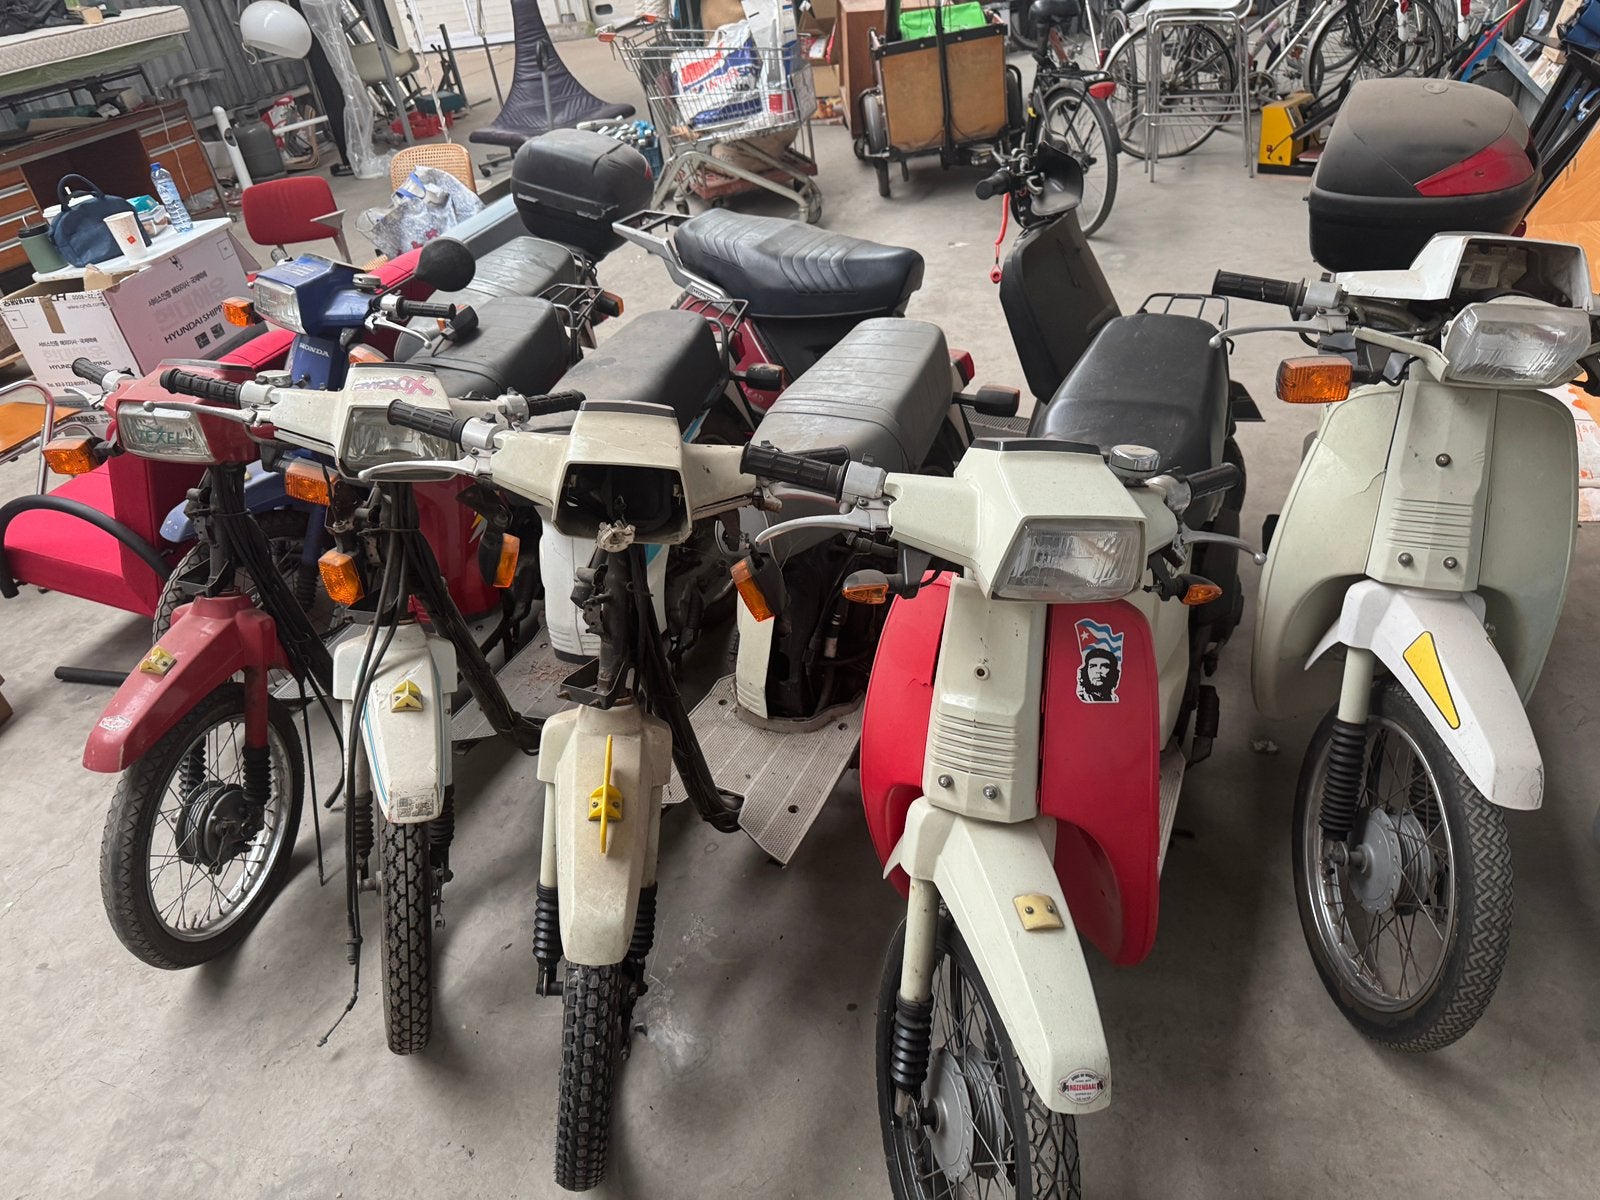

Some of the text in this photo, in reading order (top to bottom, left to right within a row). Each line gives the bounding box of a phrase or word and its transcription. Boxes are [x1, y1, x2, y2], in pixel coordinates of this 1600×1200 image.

[164, 304, 223, 343] HYUNDAI SHIPP
[299, 342, 330, 358] HONDA
[137, 426, 186, 445] TEXEL
